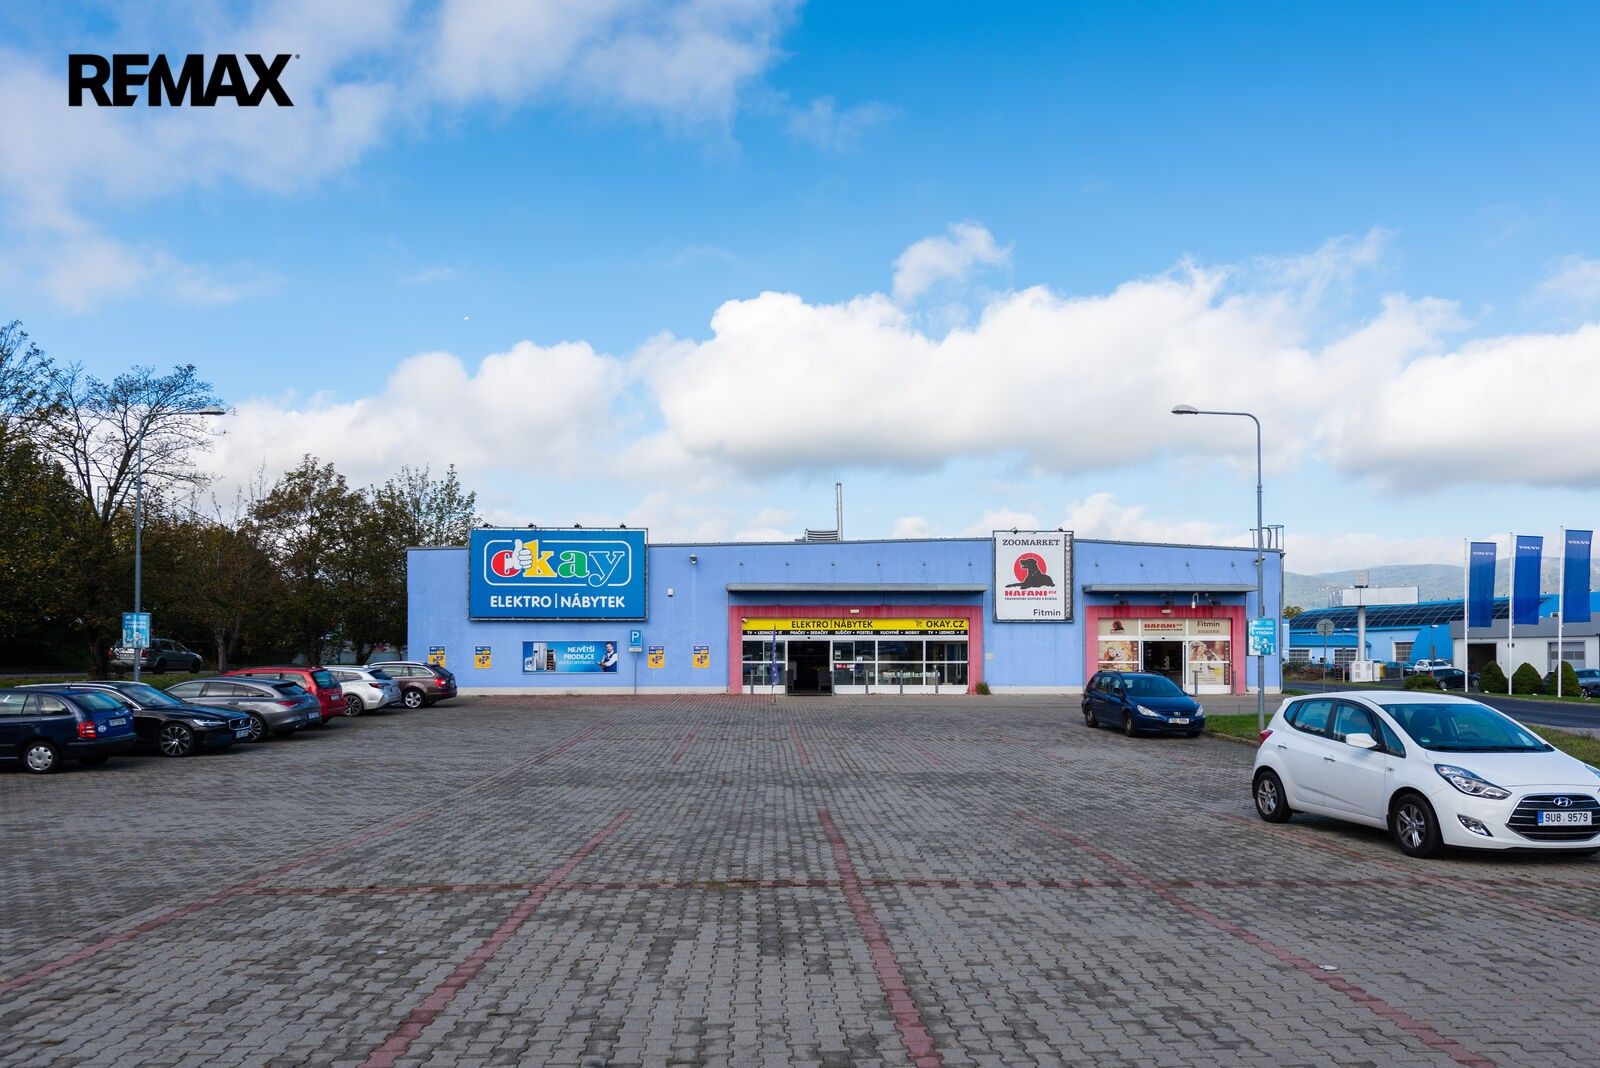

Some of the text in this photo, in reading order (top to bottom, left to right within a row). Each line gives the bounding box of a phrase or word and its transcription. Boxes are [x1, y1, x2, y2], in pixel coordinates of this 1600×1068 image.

[490, 592, 626, 608] ELEKTRO NÁBYTEK
[1033, 608, 1061, 616] Fitmin
[791, 618, 965, 629] ELEKTRO NÁBYTEK OKAY.CZ
[1197, 620, 1220, 628] Fitmin
[631, 631, 640, 642] P
[567, 645, 595, 653] NEJVĚTŠÍ
[1545, 812, 1588, 823] 9U8 9579
